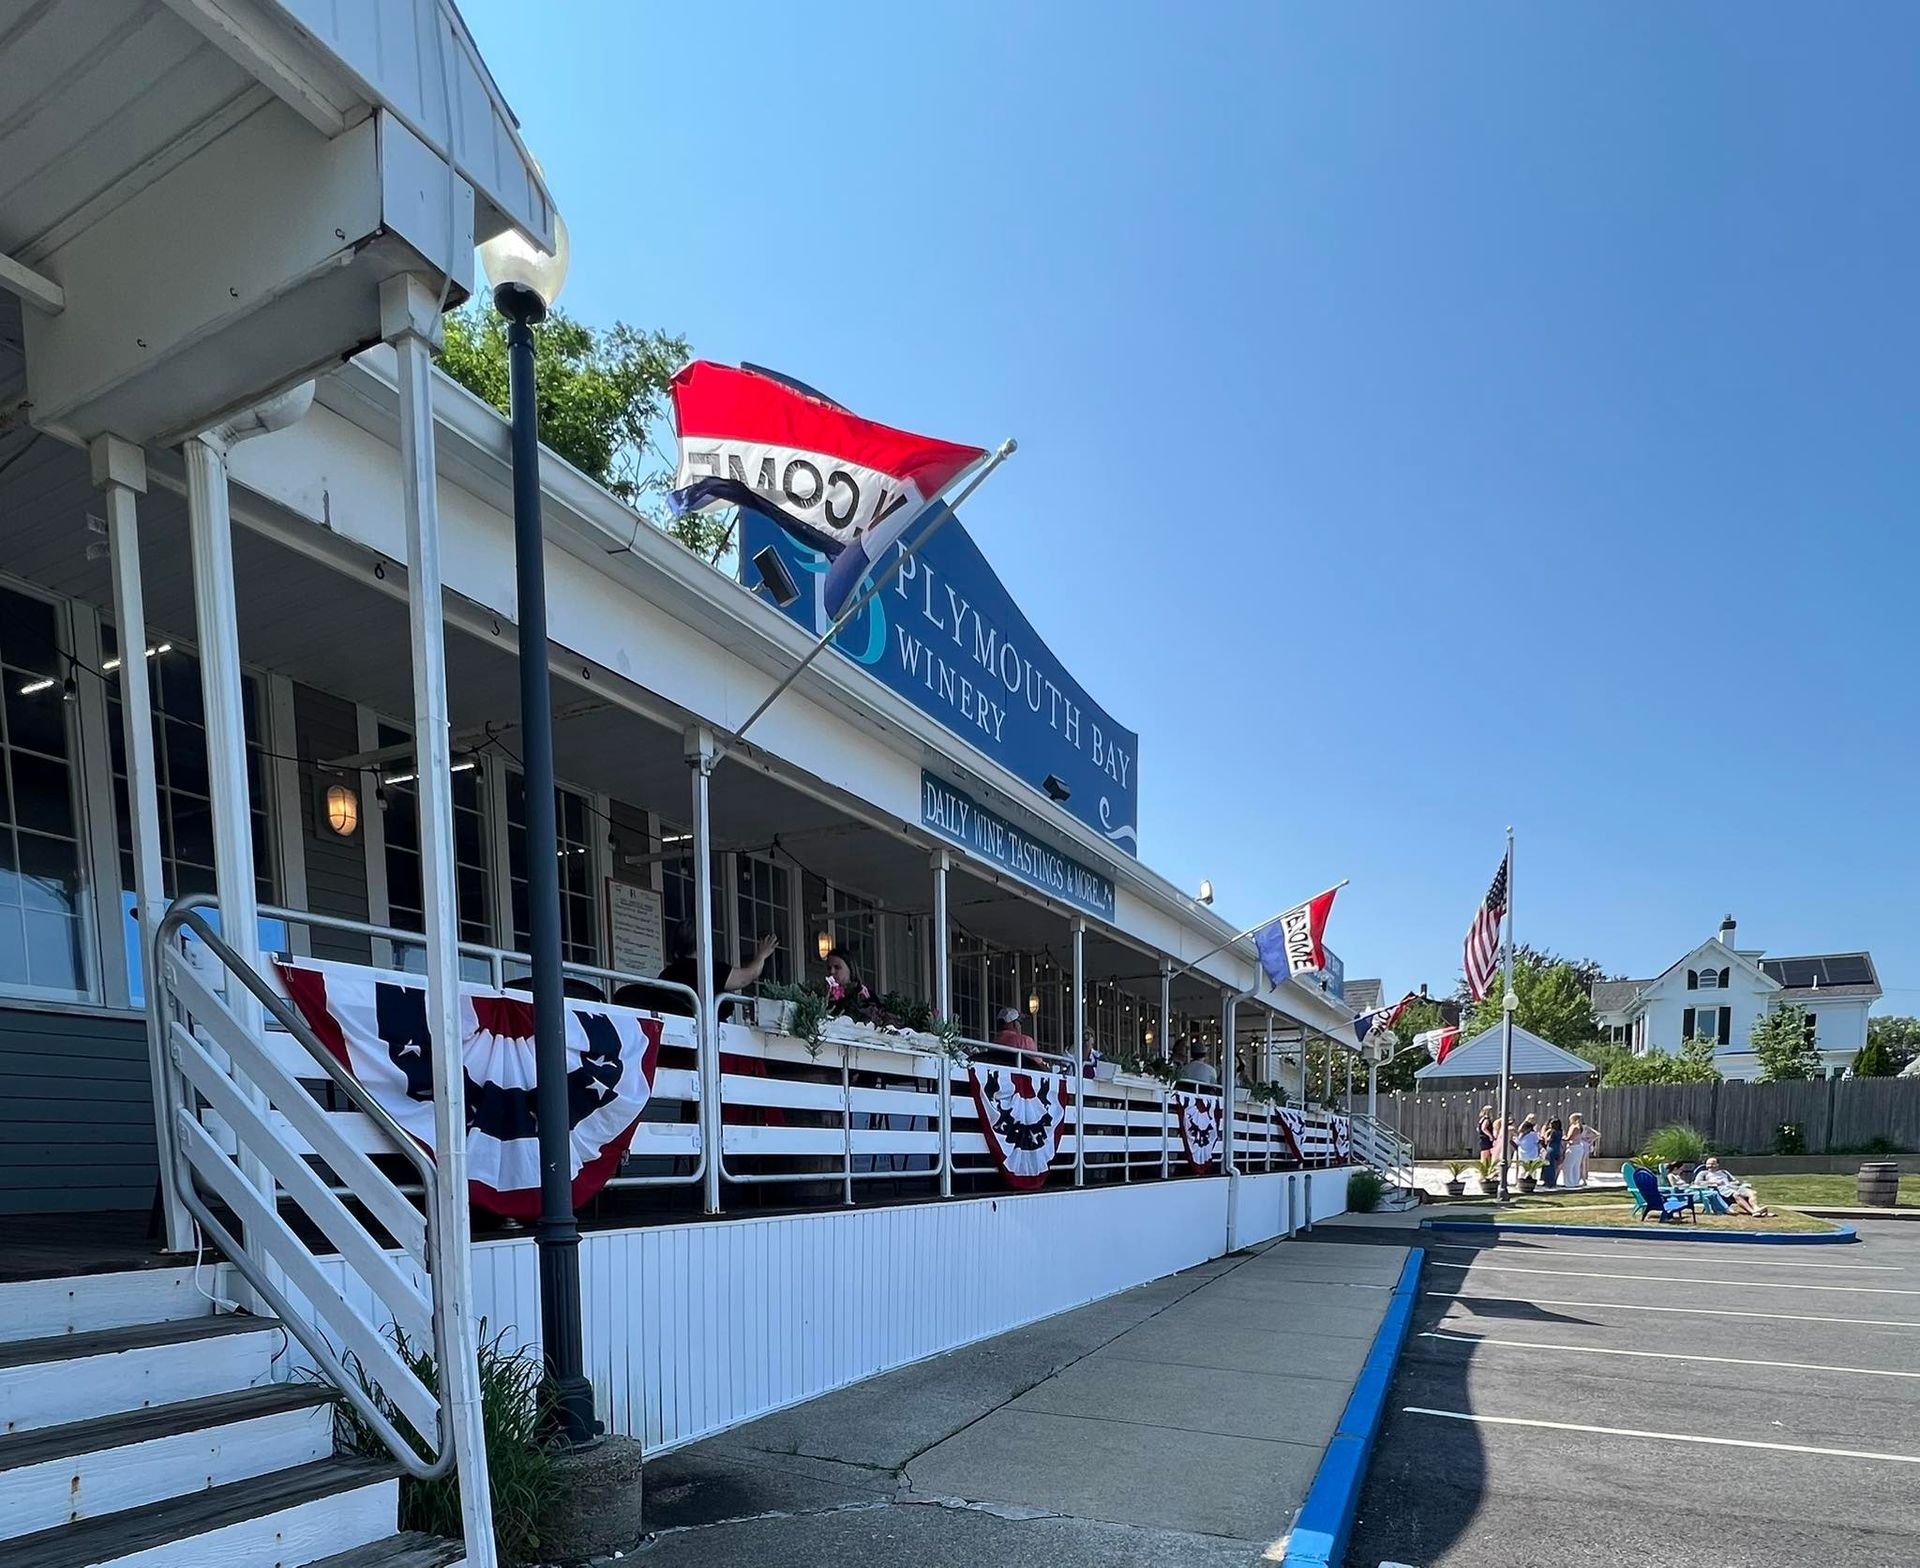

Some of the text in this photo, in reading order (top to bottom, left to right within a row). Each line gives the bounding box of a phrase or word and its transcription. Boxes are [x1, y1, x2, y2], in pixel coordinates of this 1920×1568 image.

[895, 539, 1081, 749] PLYMOUTH
[1092, 725, 1130, 790] BAY
[895, 624, 1006, 743] WINERY
[926, 781, 969, 839] DAILY
[973, 810, 1004, 860] WINE
[1009, 831, 1064, 890] TASTINGS
[1067, 864, 1073, 894] &
